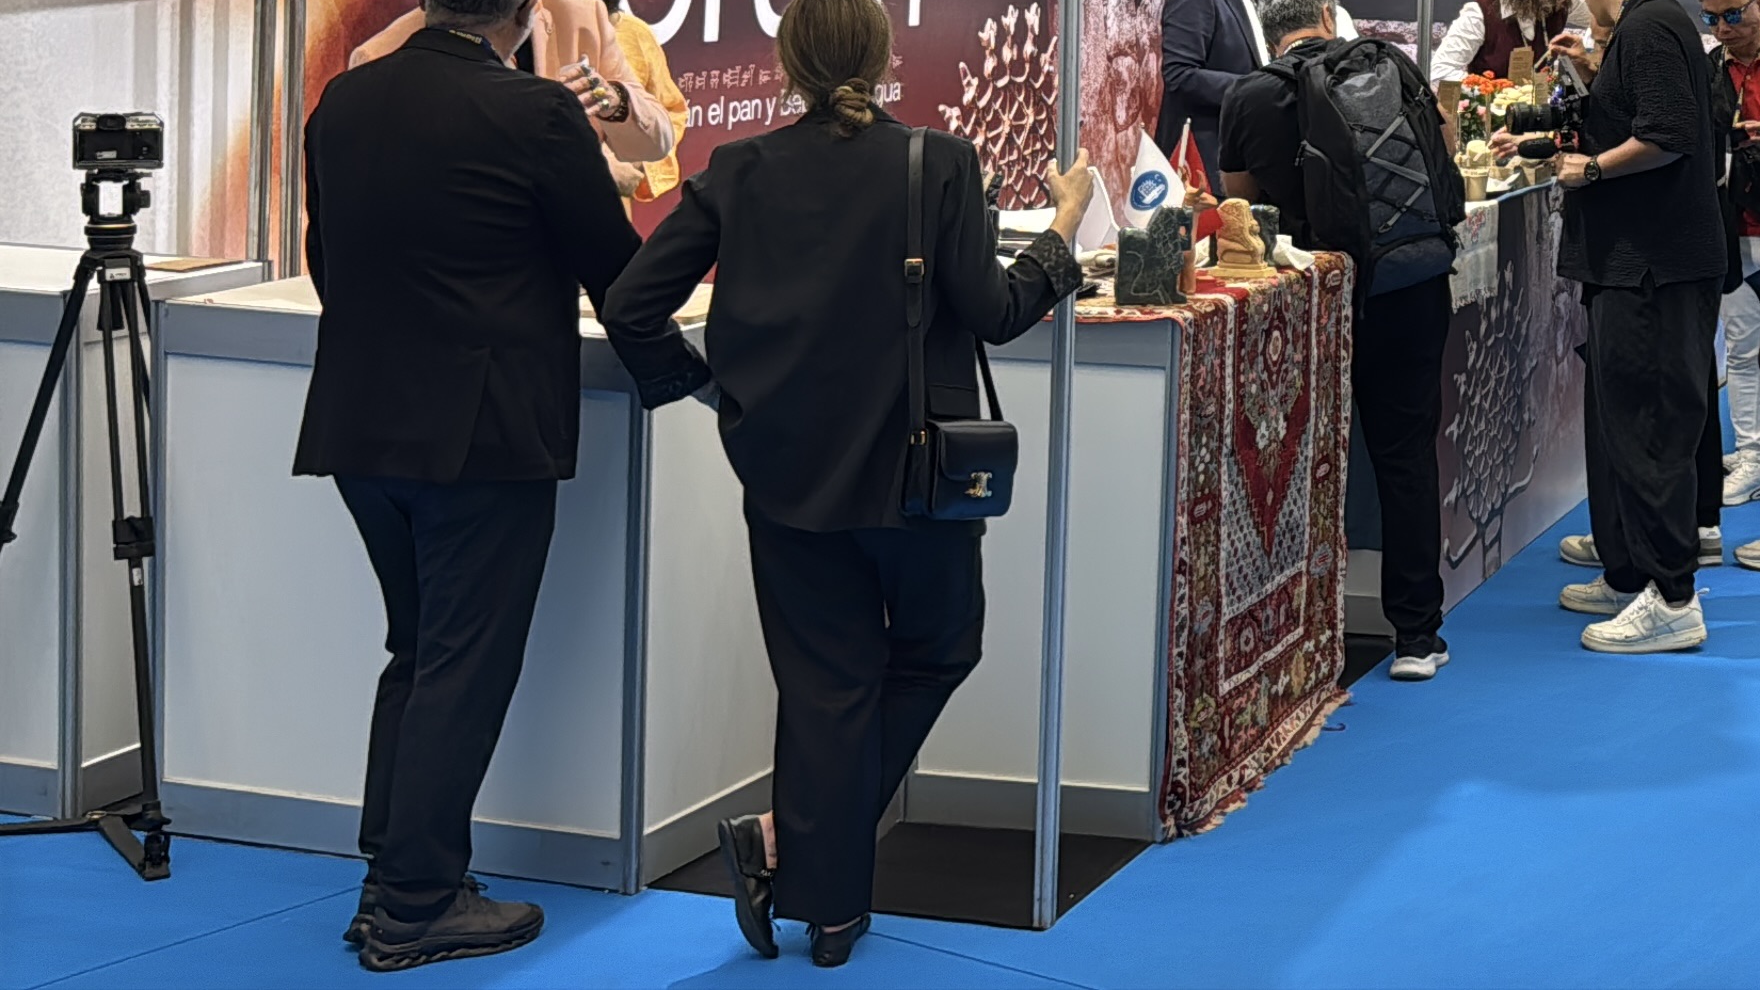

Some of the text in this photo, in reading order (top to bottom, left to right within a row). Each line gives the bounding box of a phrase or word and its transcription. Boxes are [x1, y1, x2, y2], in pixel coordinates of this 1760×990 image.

[707, 96, 724, 125] el
[727, 97, 761, 130] pan
[764, 95, 777, 125] y
